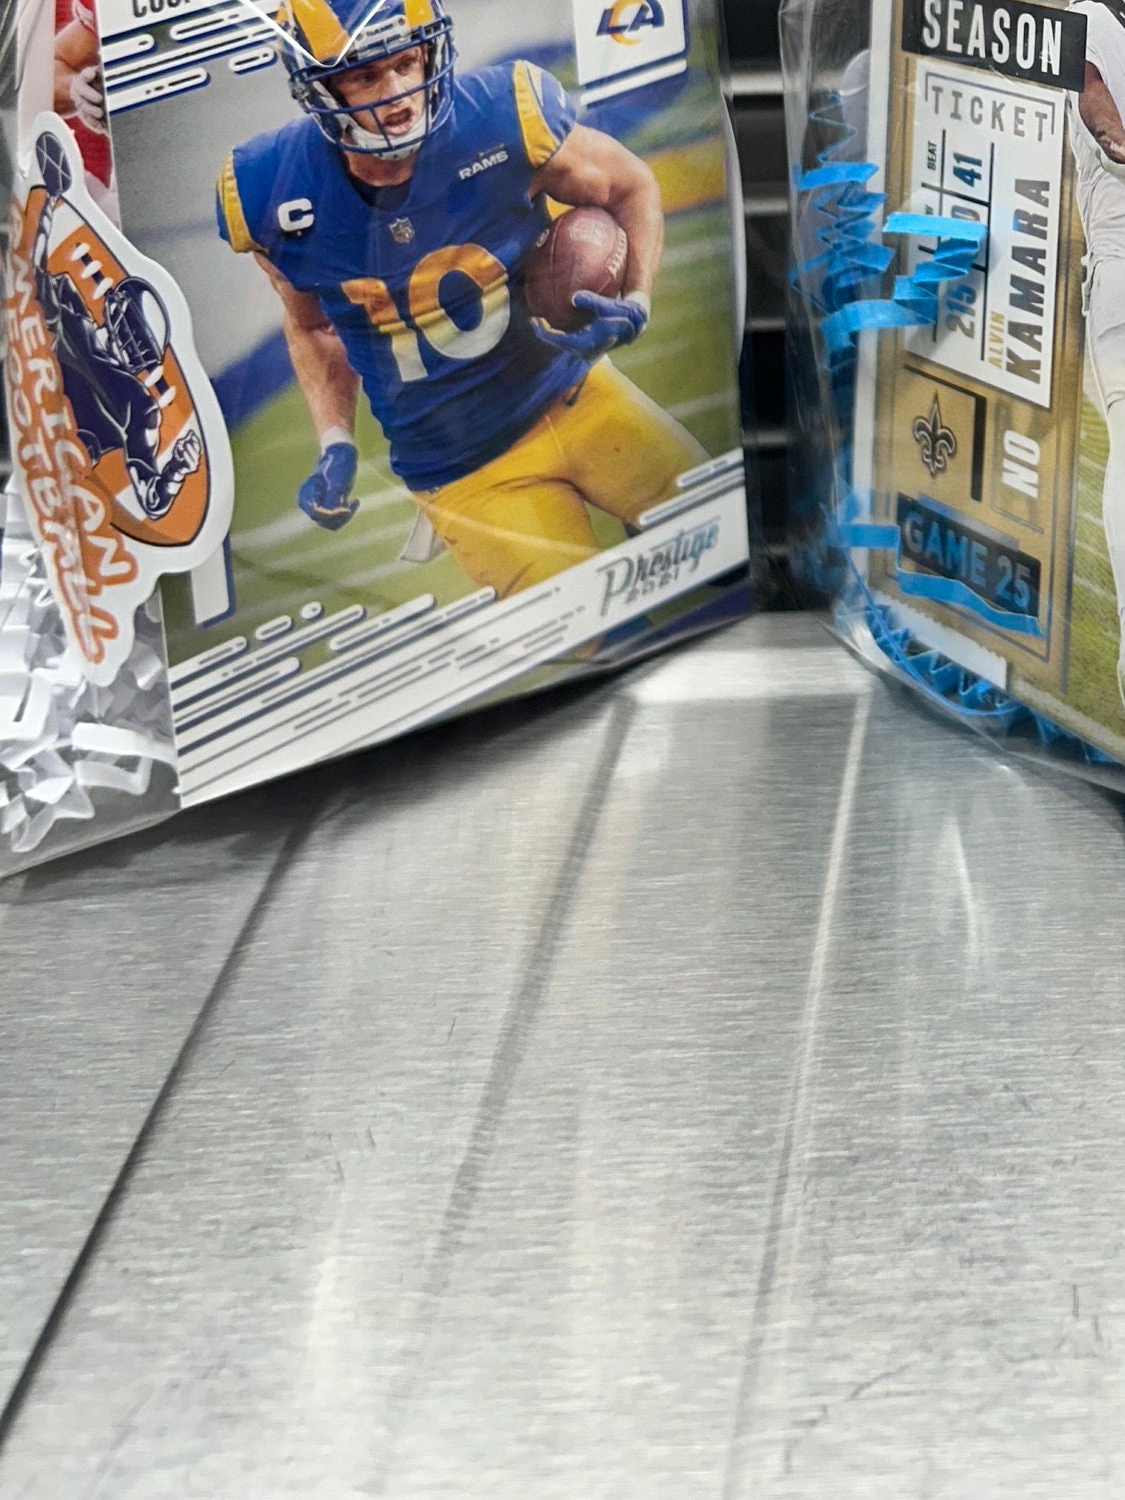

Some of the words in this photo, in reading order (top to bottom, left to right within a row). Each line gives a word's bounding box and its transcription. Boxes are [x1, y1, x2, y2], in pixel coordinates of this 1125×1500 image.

[931, 84, 1049, 143] TICKET
[458, 150, 510, 181] RAMS
[953, 151, 983, 188] 41
[277, 198, 315, 232] C
[341, 243, 511, 382] 10
[1006, 178, 1051, 385] KAMARA
[988, 310, 1006, 370] ALVIN
[1001, 429, 1041, 500] NO
[597, 516, 720, 617] Prestige
[903, 510, 989, 588] GAME
[994, 555, 1031, 609] 25
